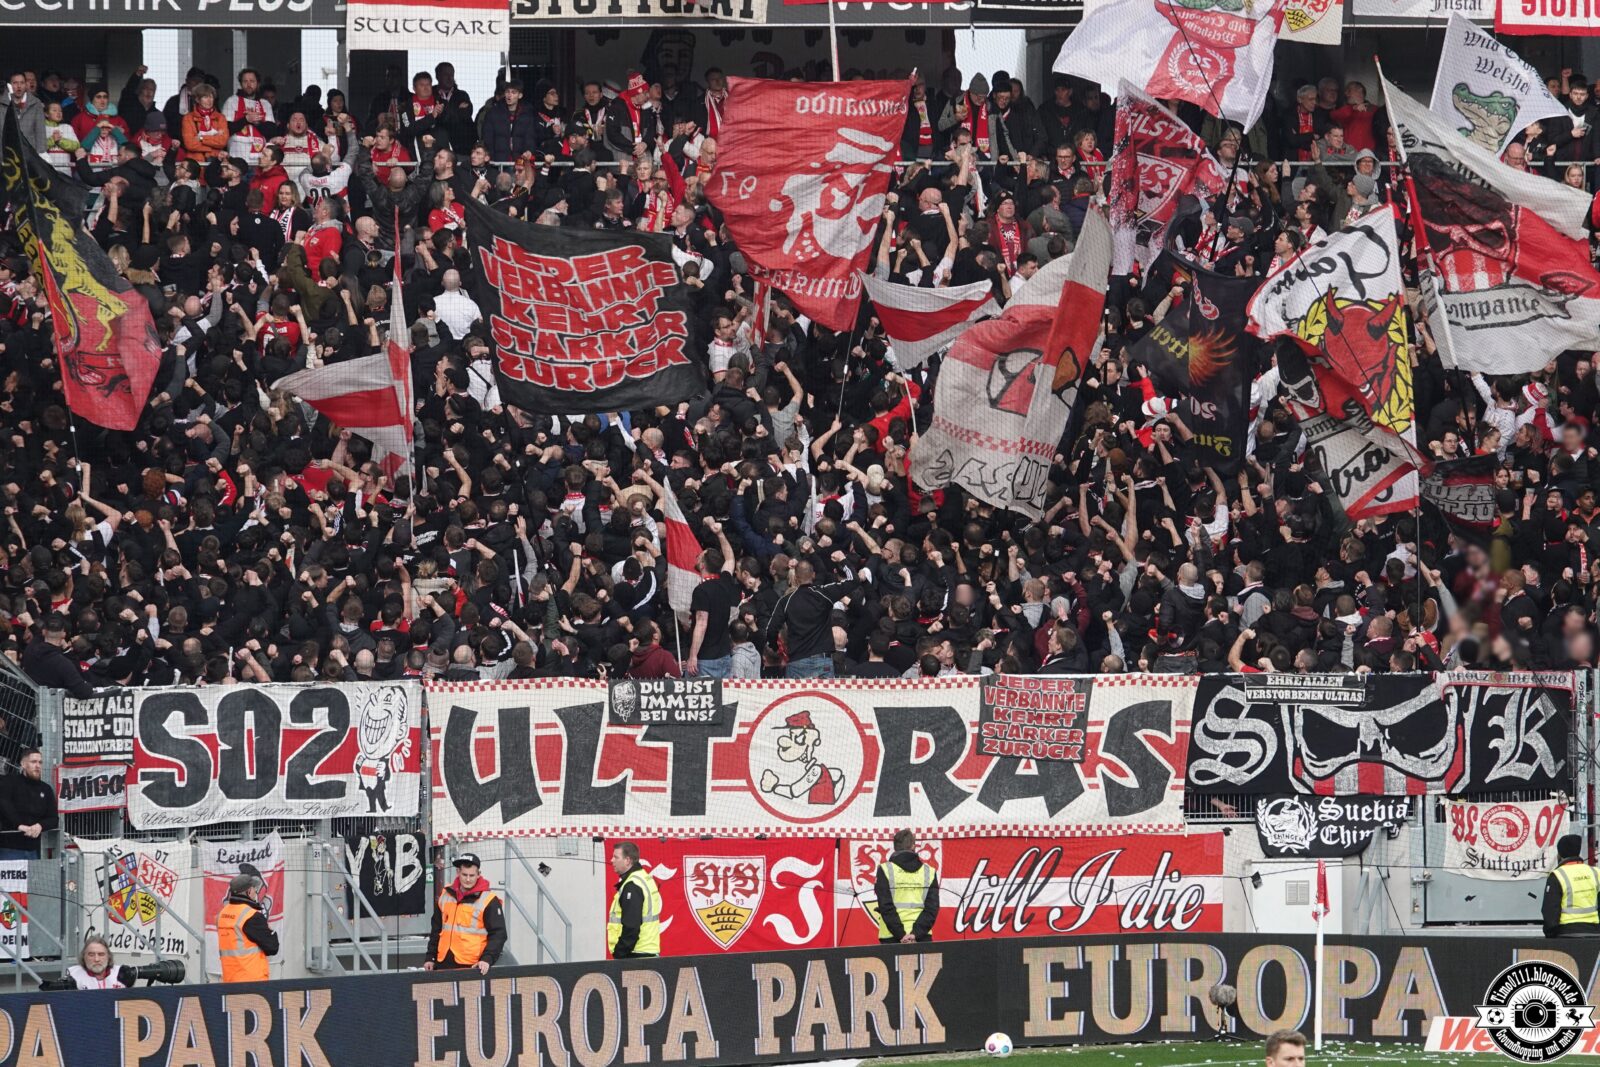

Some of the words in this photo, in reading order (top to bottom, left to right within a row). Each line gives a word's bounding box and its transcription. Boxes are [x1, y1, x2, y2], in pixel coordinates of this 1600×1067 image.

[354, 16, 503, 37] STUTTGART
[492, 235, 648, 284] JEDER
[478, 245, 680, 316] VERBANNTE
[500, 287, 665, 335] KEHRT
[641, 680, 666, 694] DU
[673, 680, 715, 694] BIST
[996, 677, 1076, 692] JEDER
[1246, 689, 1326, 701] VERSTORBENEN
[1325, 690, 1363, 702] ULTRAS
[639, 693, 715, 710] IMMER
[984, 686, 1085, 713] VERBANNTE
[640, 709, 669, 722] BEI
[674, 709, 716, 722] UNS!
[992, 707, 1078, 727] KEHRT
[216, 842, 273, 864] Leintal
[1460, 847, 1547, 878] Stuttgart
[954, 846, 1064, 933] till
[1119, 851, 1205, 931] die
[114, 988, 333, 1067] PARK
[411, 965, 720, 1067] EUROPA
[751, 953, 946, 1056] PARK
[1022, 944, 1449, 1042] EUROPA
